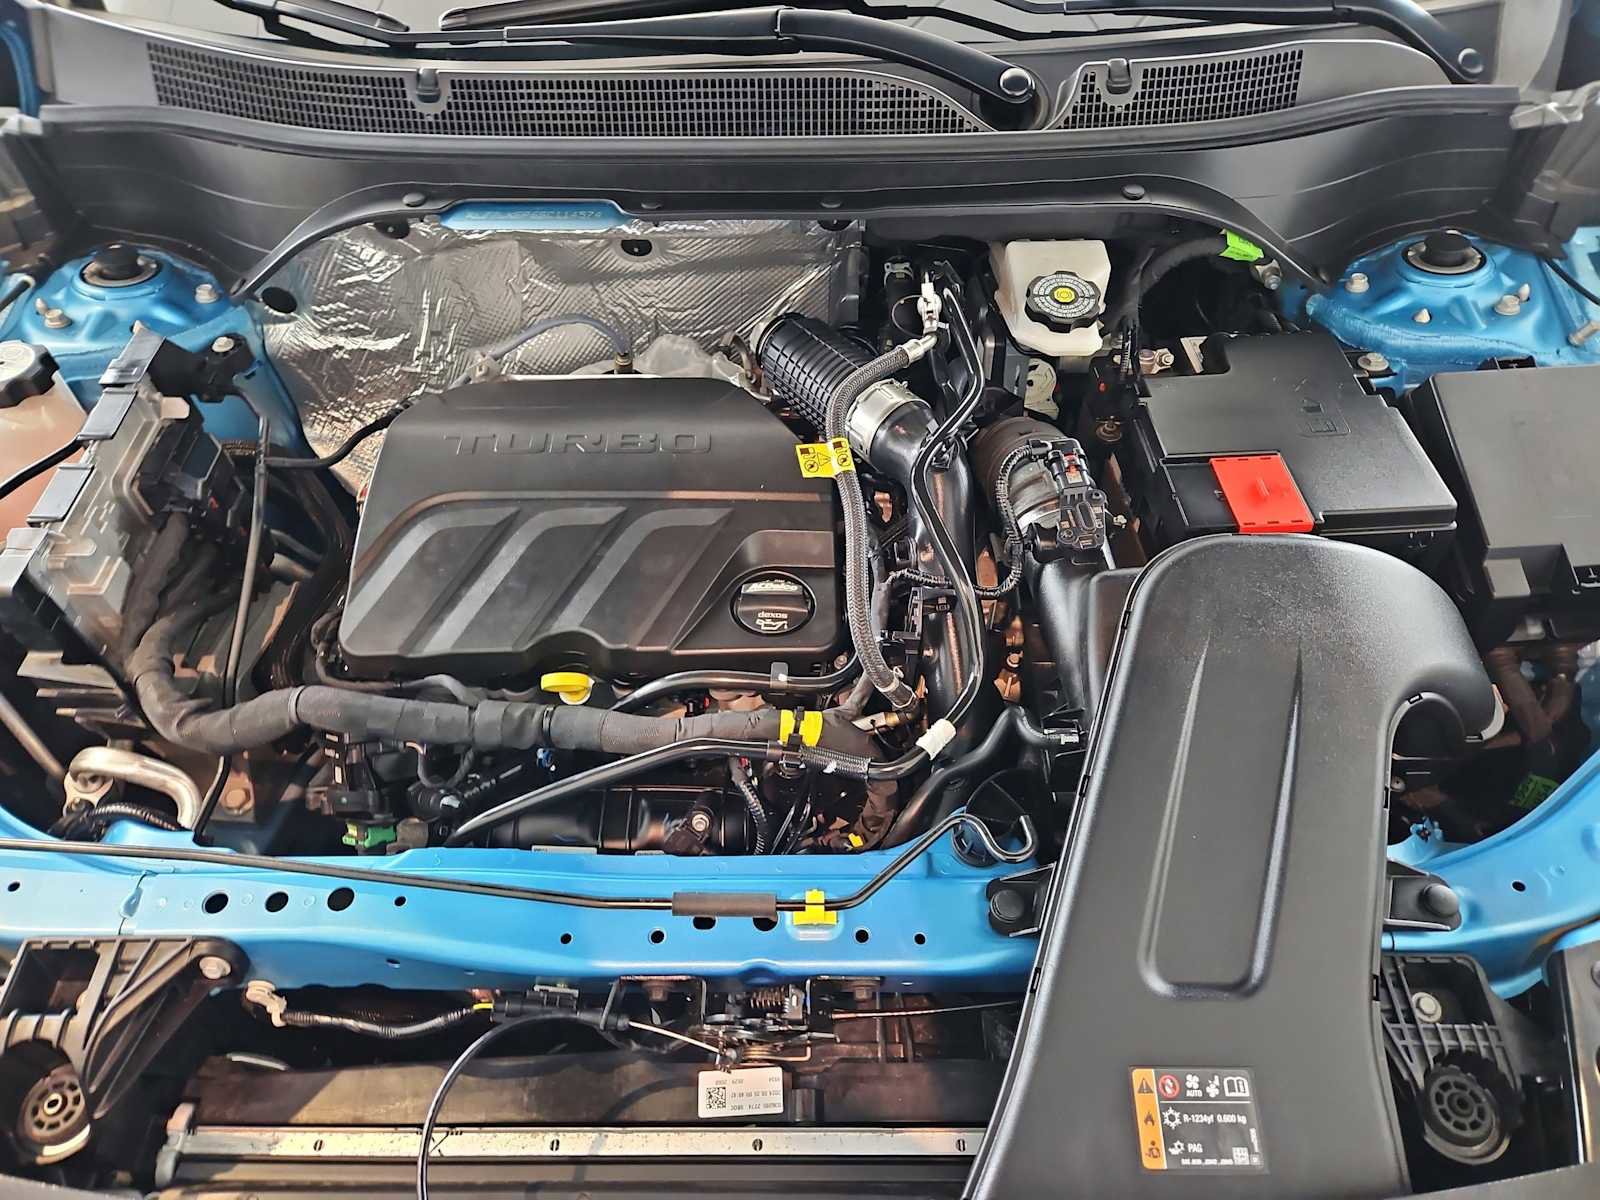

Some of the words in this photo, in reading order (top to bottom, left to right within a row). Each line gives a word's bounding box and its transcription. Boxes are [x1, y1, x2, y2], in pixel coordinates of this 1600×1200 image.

[444, 432, 712, 455] TURBO
[758, 611, 788, 619] dexos
[1186, 1089, 1203, 1097] AUTO
[1183, 1114, 1214, 1125] R-1234yf
[1237, 1114, 1247, 1125] kg
[1187, 1143, 1203, 1153] PAG
